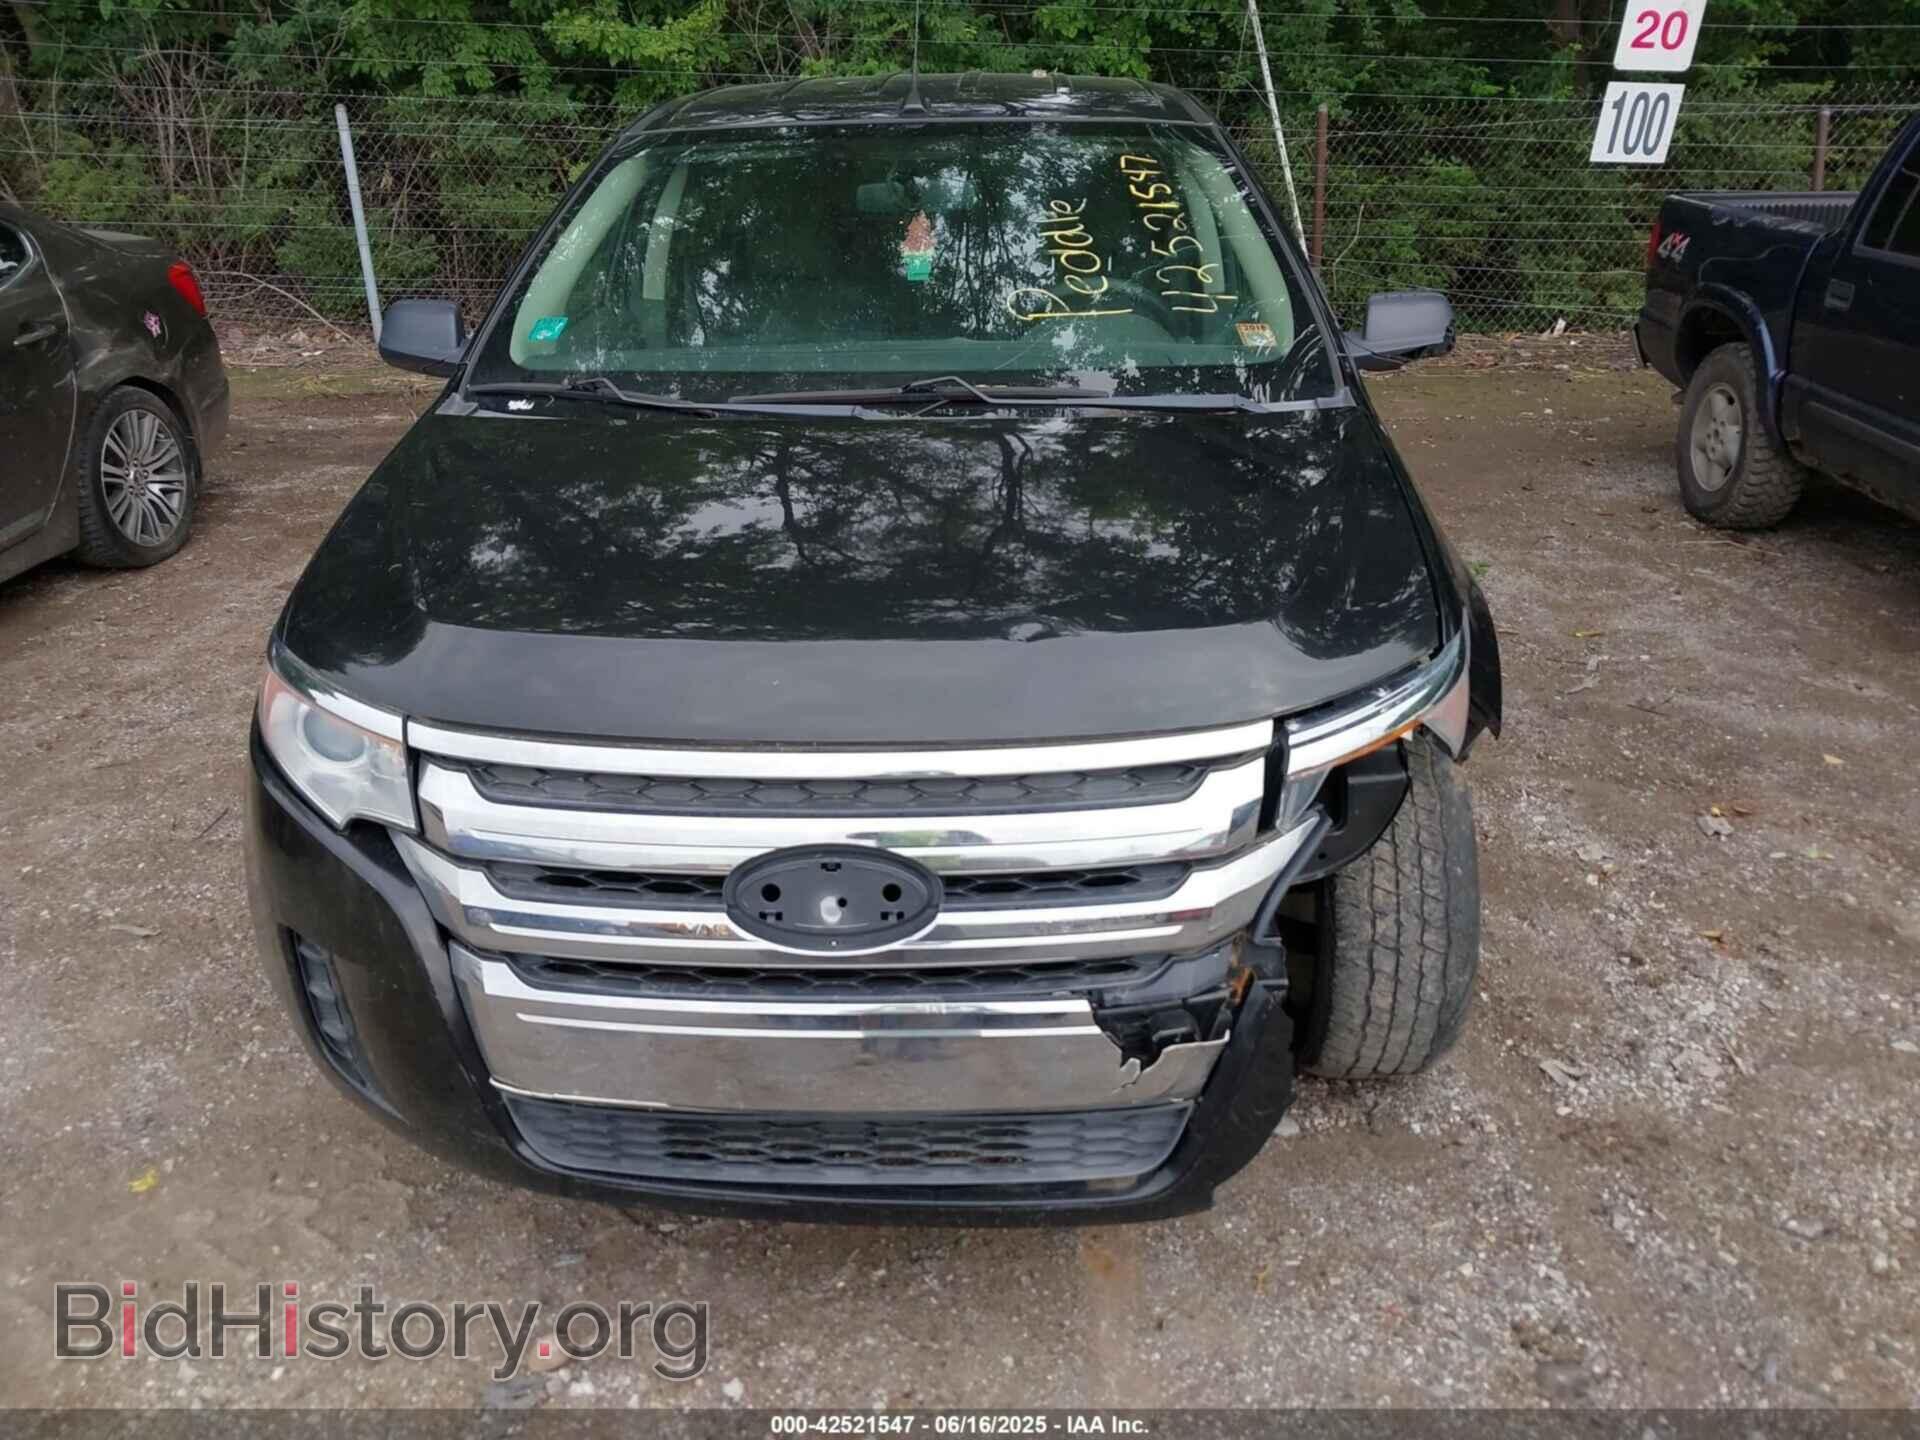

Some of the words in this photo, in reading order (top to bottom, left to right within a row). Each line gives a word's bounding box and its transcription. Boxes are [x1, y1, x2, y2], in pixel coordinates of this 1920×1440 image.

[1630, 10, 1688, 50] 20
[1607, 91, 1670, 156] 100
[1007, 197, 1134, 321] Peddle
[1120, 154, 1238, 313] 42521547
